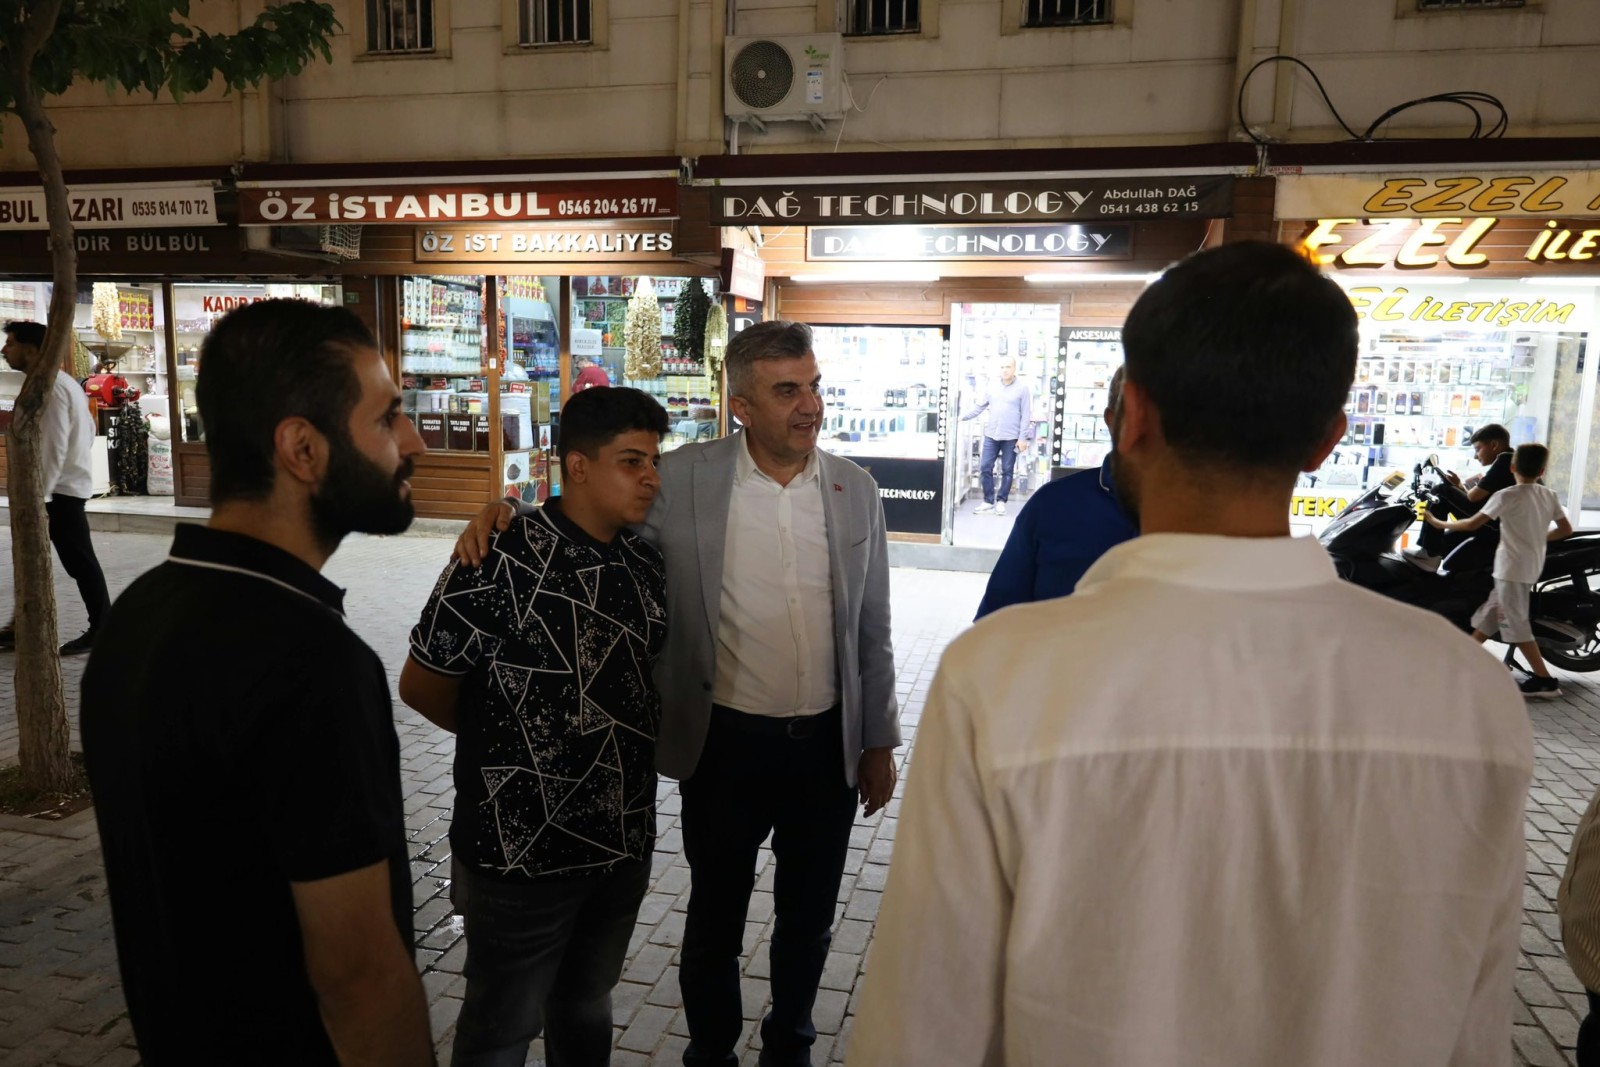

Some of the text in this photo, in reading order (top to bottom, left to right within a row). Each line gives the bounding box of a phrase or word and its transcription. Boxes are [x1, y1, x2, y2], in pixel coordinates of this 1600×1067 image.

[1103, 184, 1197, 199] Abdullah DAĞ
[1362, 177, 1568, 213] EZEL
[47, 197, 123, 222] ZARI
[132, 201, 157, 216] 0535
[159, 200, 178, 216] 814
[179, 200, 192, 215] 70
[194, 199, 208, 214] 72
[259, 190, 316, 221] ÖZ
[558, 199, 591, 215] 0546
[593, 198, 619, 214] 204
[621, 198, 638, 214] 26
[640, 197, 657, 213] 77
[723, 190, 1094, 218] DAĞ TECHNOLOGY
[1099, 201, 1199, 214] 0541 438 62 15
[126, 233, 210, 251] BÜLBÜL
[422, 231, 454, 253] ÖZ
[824, 232, 1112, 254] DA ECHNOLOGY
[1305, 218, 1496, 266] EZEL
[1407, 296, 1574, 327] İLETİŞİM
[1068, 330, 1121, 341] AKSESUAR
[878, 488, 936, 500] TECHNOLOGY
